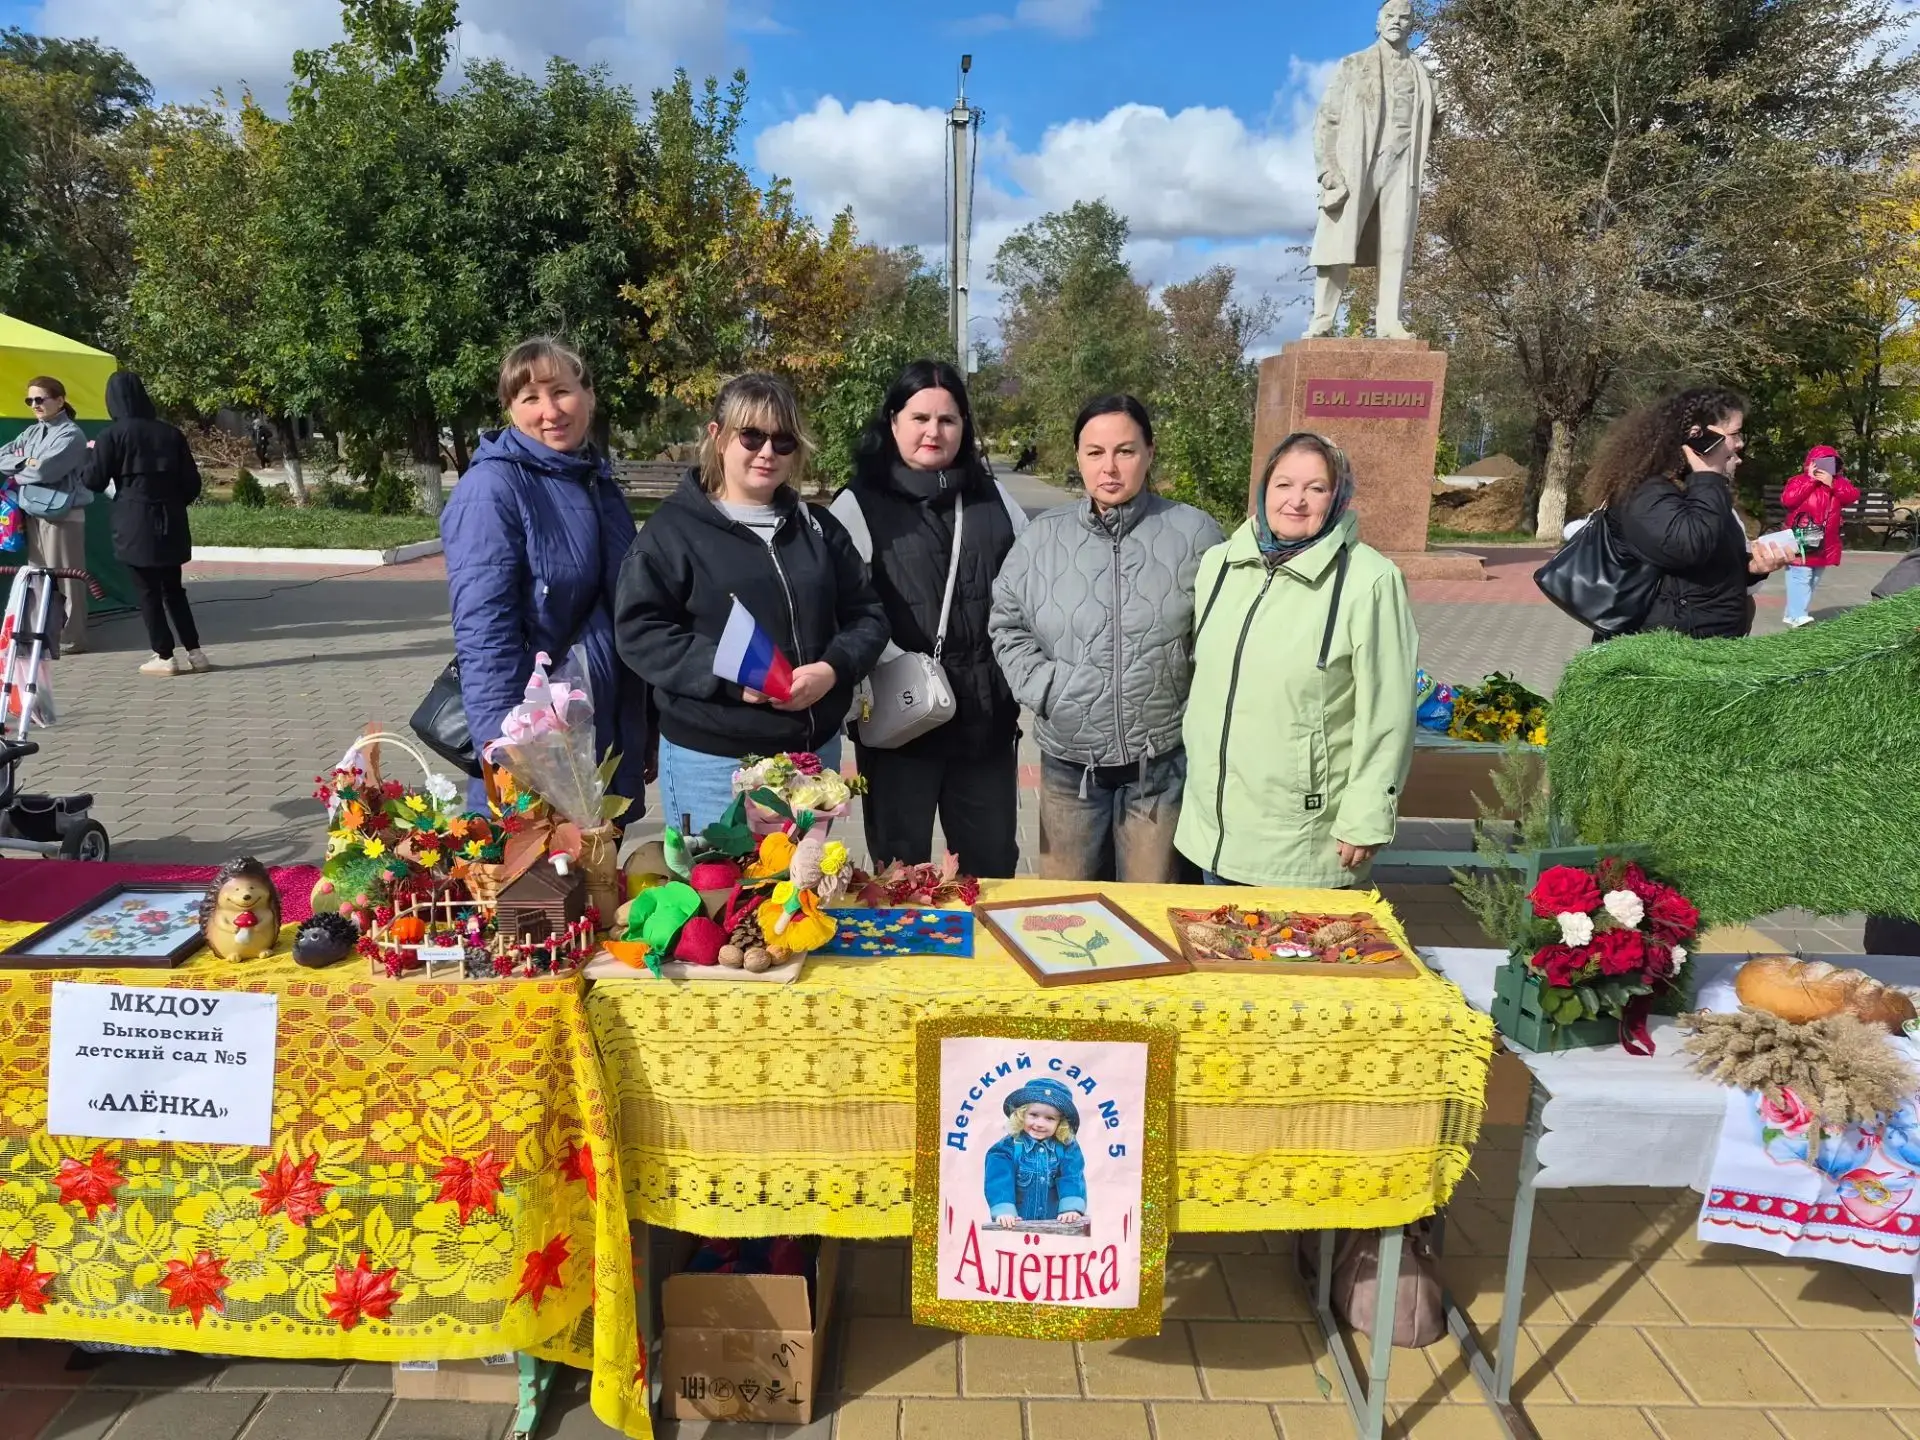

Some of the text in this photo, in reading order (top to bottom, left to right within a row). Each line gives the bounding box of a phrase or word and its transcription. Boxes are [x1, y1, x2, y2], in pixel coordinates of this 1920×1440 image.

[1312, 391, 1425, 407] В.И. ЛЕНИН
[902, 691, 914, 705] S
[110, 992, 220, 1017] МКДОУ
[102, 1022, 224, 1042] Быковский
[75, 1045, 248, 1066] детский сад №5
[88, 1089, 229, 1119] «АЛЁНКА»
[946, 1051, 1126, 1158] Детский сад № 5
